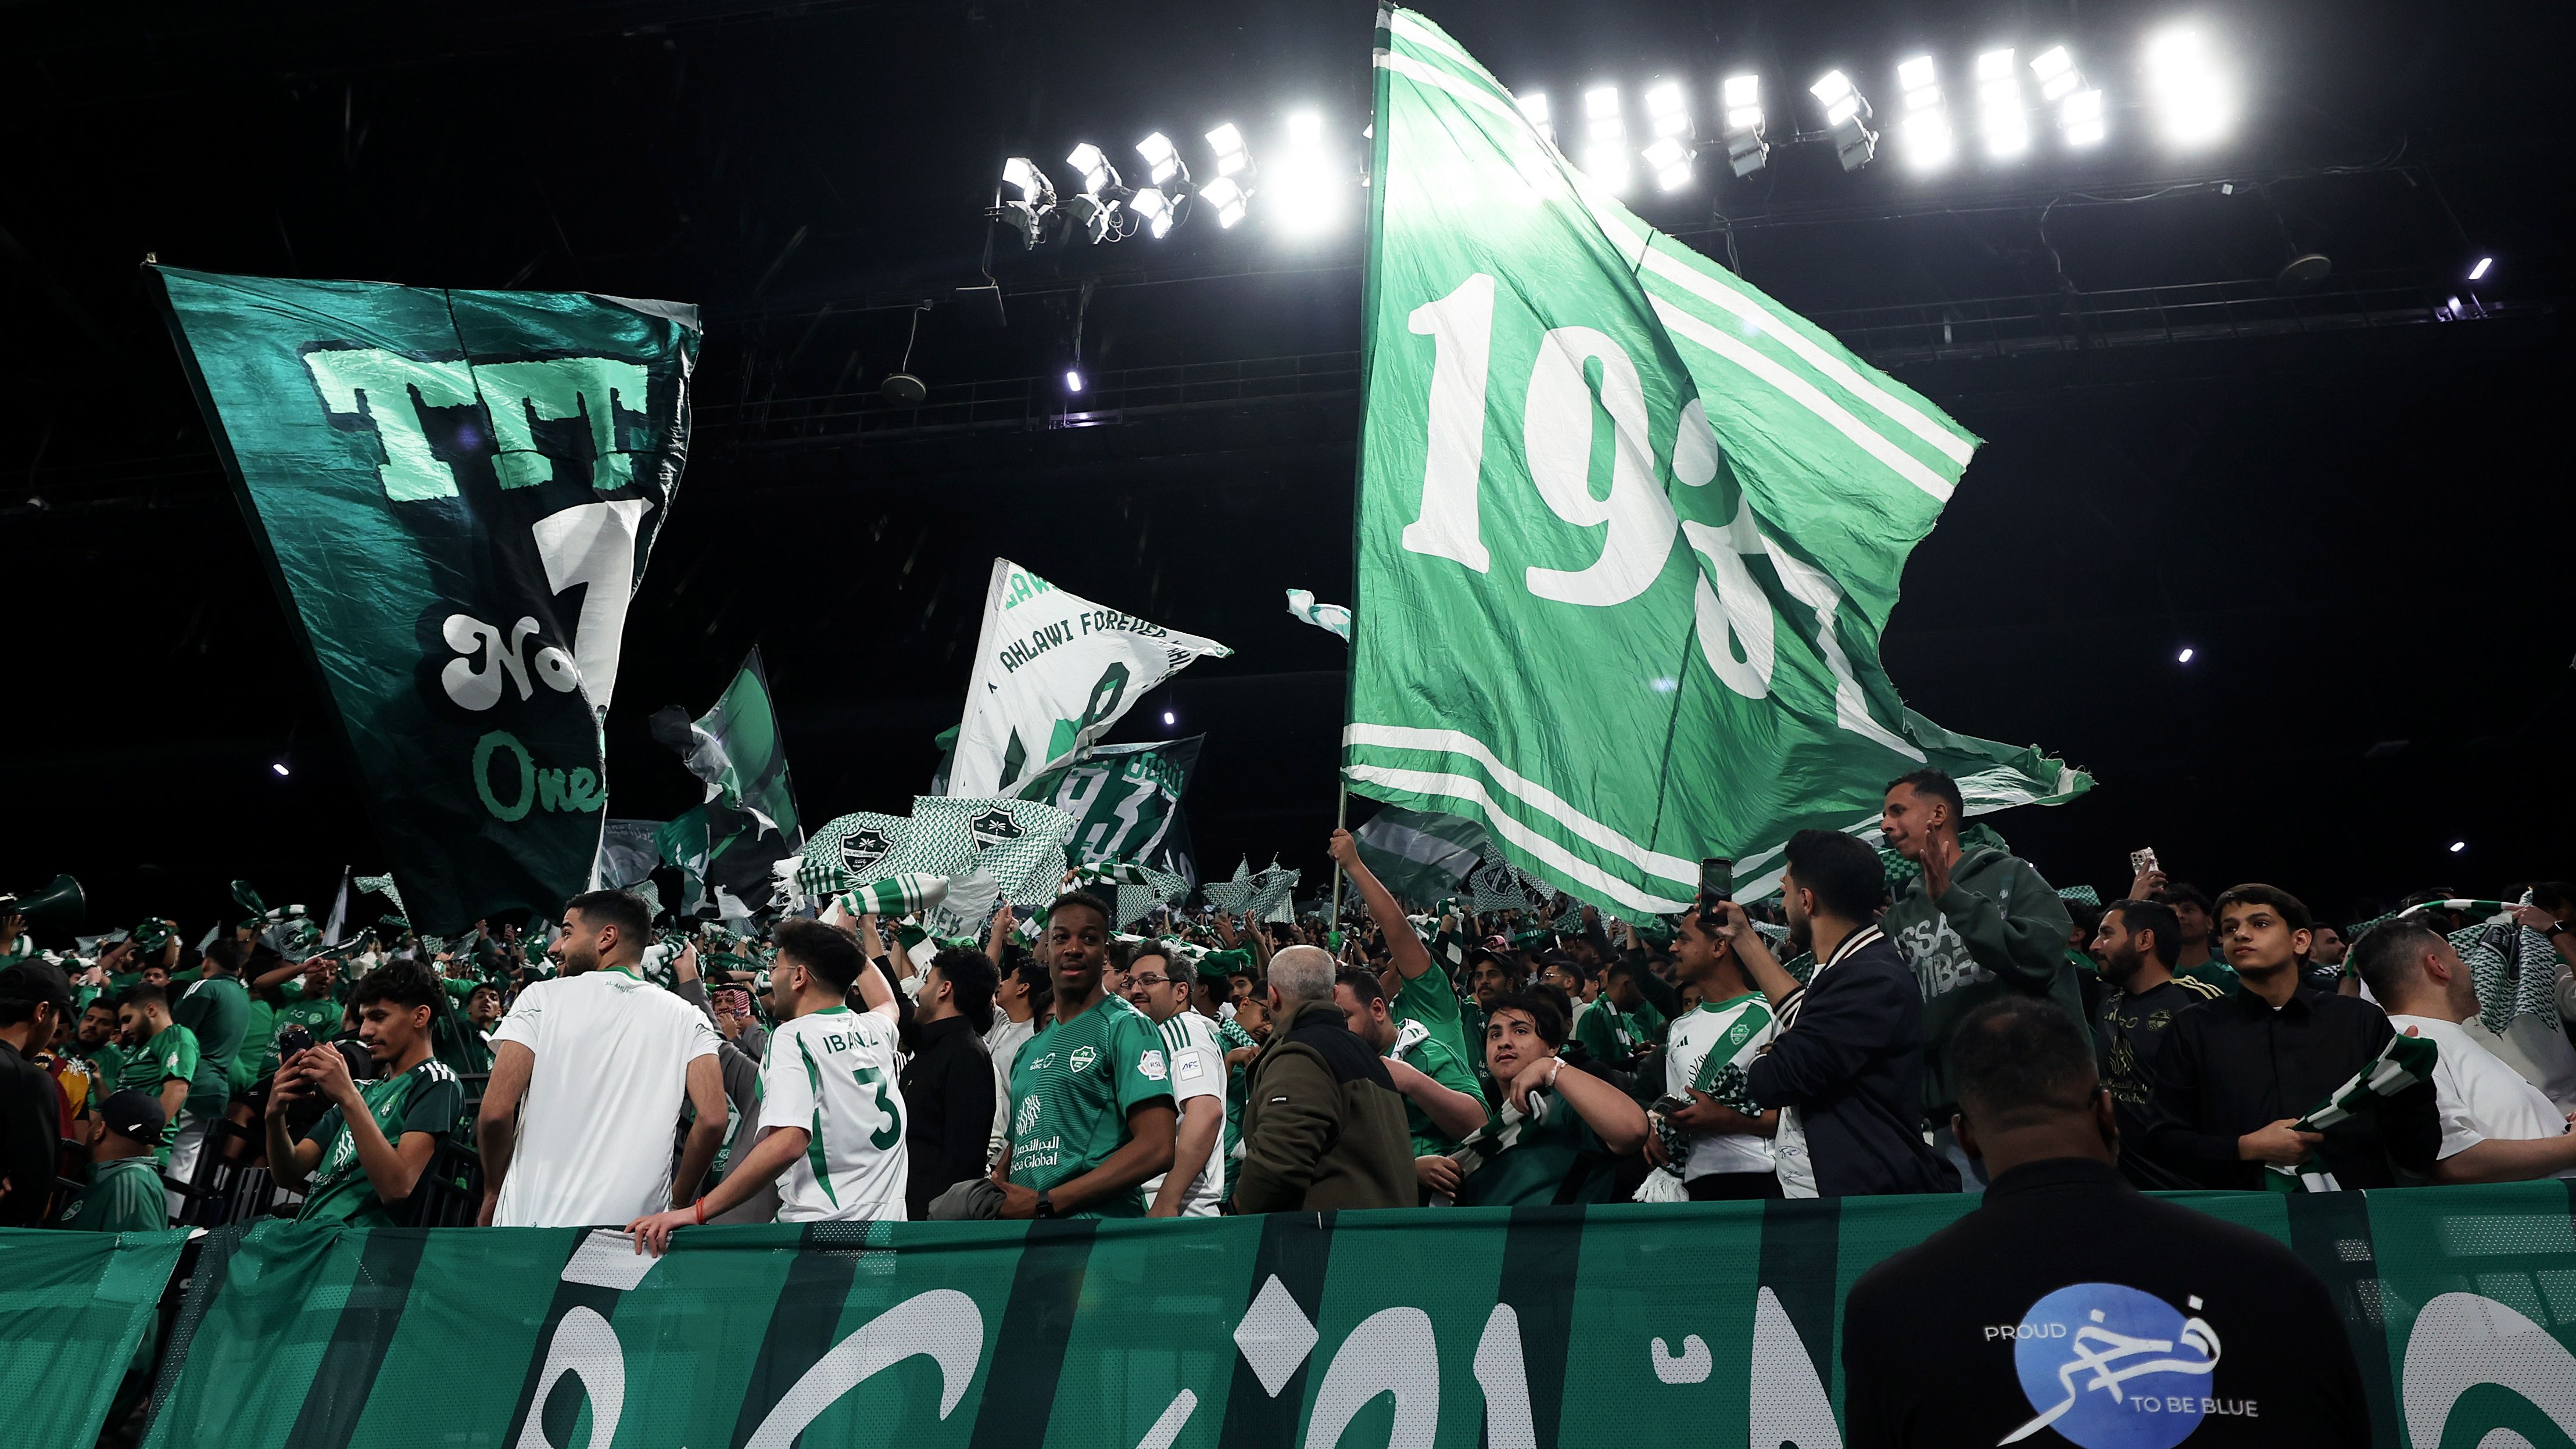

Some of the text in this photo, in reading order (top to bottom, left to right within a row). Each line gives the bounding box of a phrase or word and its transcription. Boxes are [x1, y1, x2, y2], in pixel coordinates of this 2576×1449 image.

[1000, 619, 1073, 673] AHLAWI
[1080, 610, 1167, 637] FOREVER
[442, 614, 577, 711] No
[473, 730, 607, 822] One
[823, 1031, 879, 1054] IBAN
[1182, 1061, 1199, 1070] AFC
[852, 1066, 901, 1151] 3
[1016, 1138, 1038, 1159] الأحمر
[1037, 1136, 1059, 1154] البحر
[1024, 1152, 1058, 1168] Global
[1984, 1323, 2067, 1342] PROUD
[2130, 1396, 2259, 1418] TO BE BLUE
